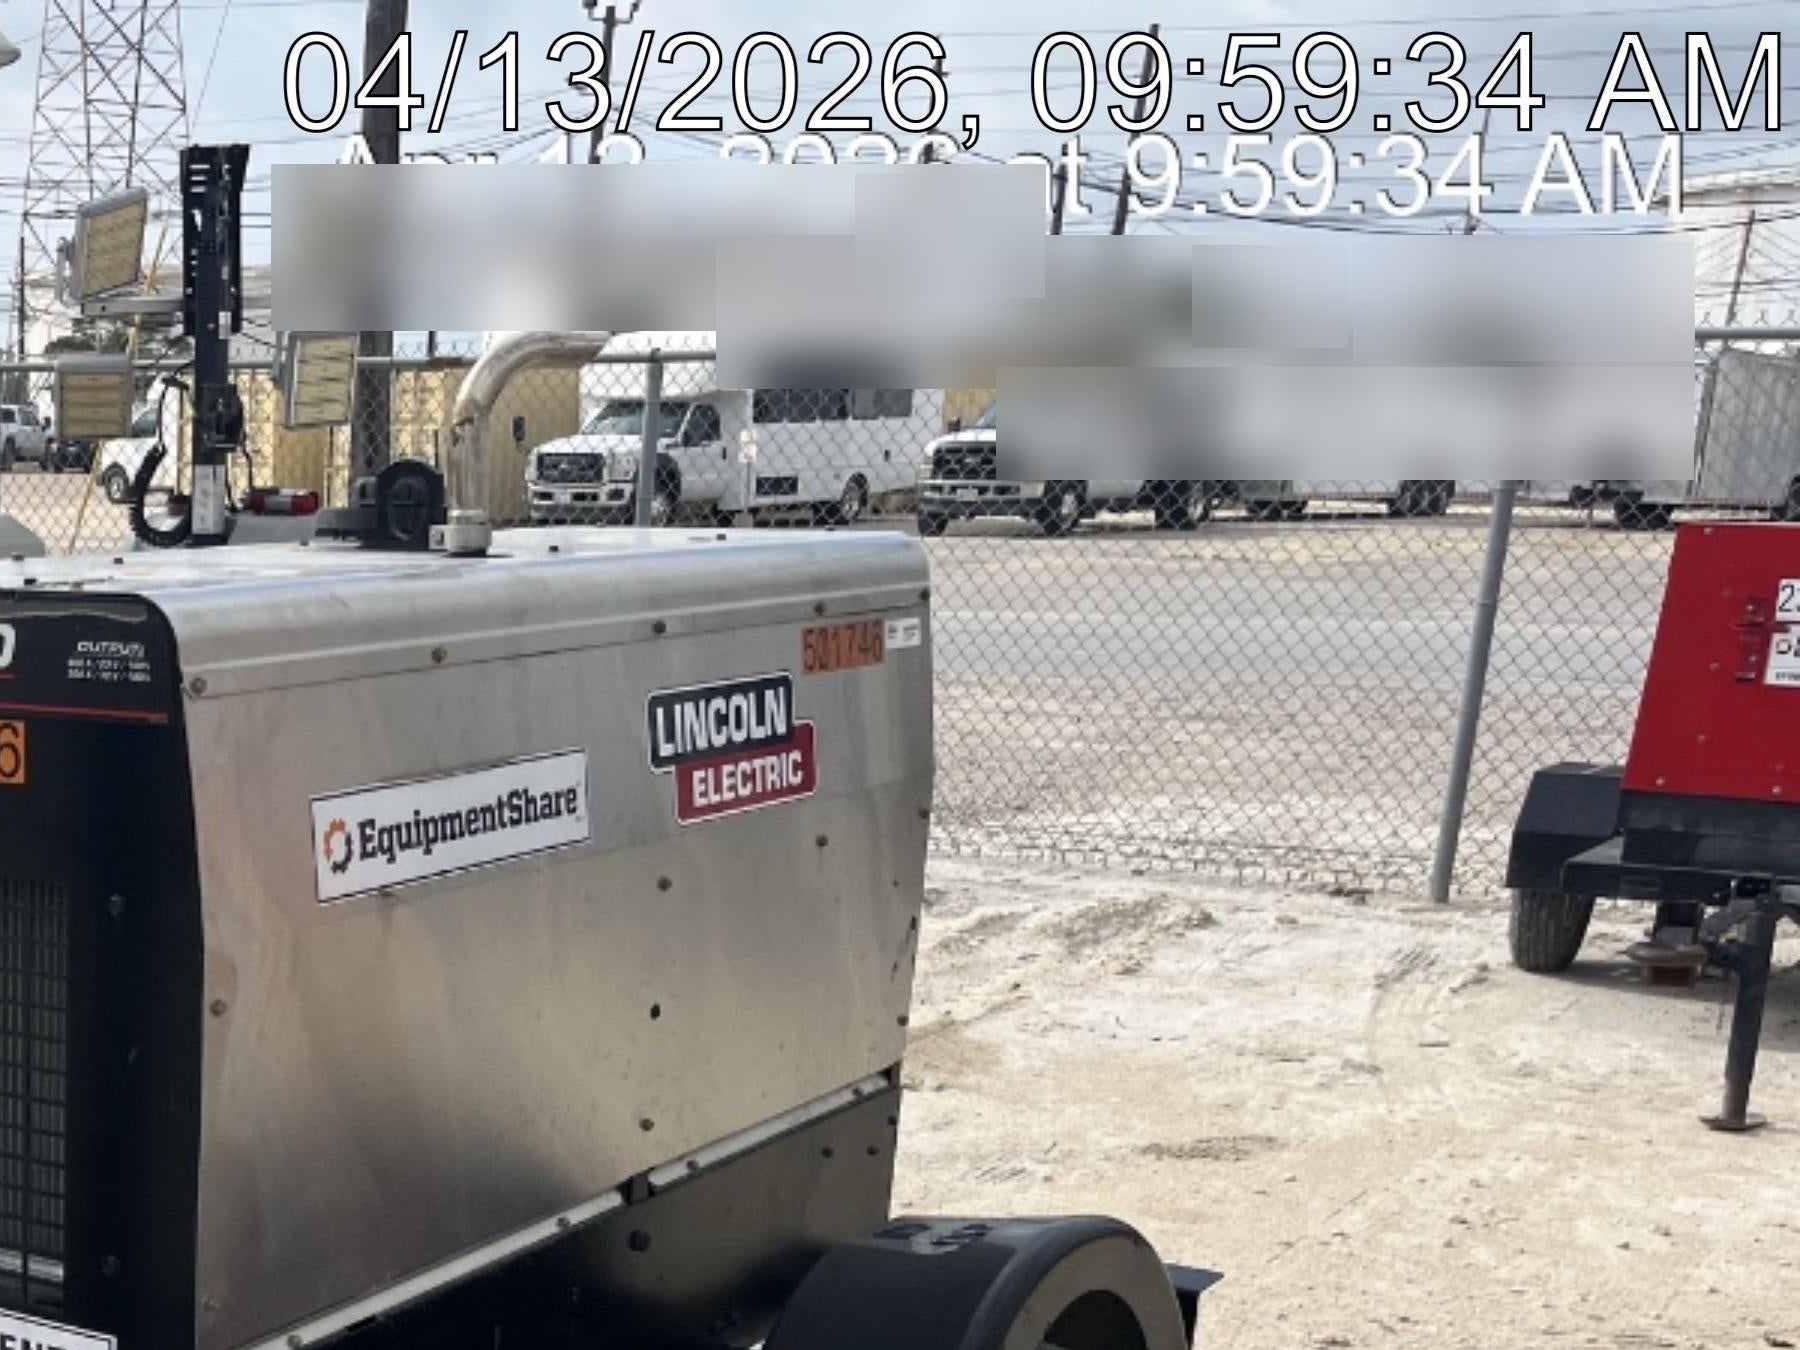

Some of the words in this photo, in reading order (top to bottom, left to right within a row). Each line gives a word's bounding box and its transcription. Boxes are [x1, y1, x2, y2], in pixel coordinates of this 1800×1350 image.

[655, 686, 787, 757] LINCOLN
[691, 750, 803, 808] ELECTRIC
[357, 787, 578, 864] EquipmentShare
